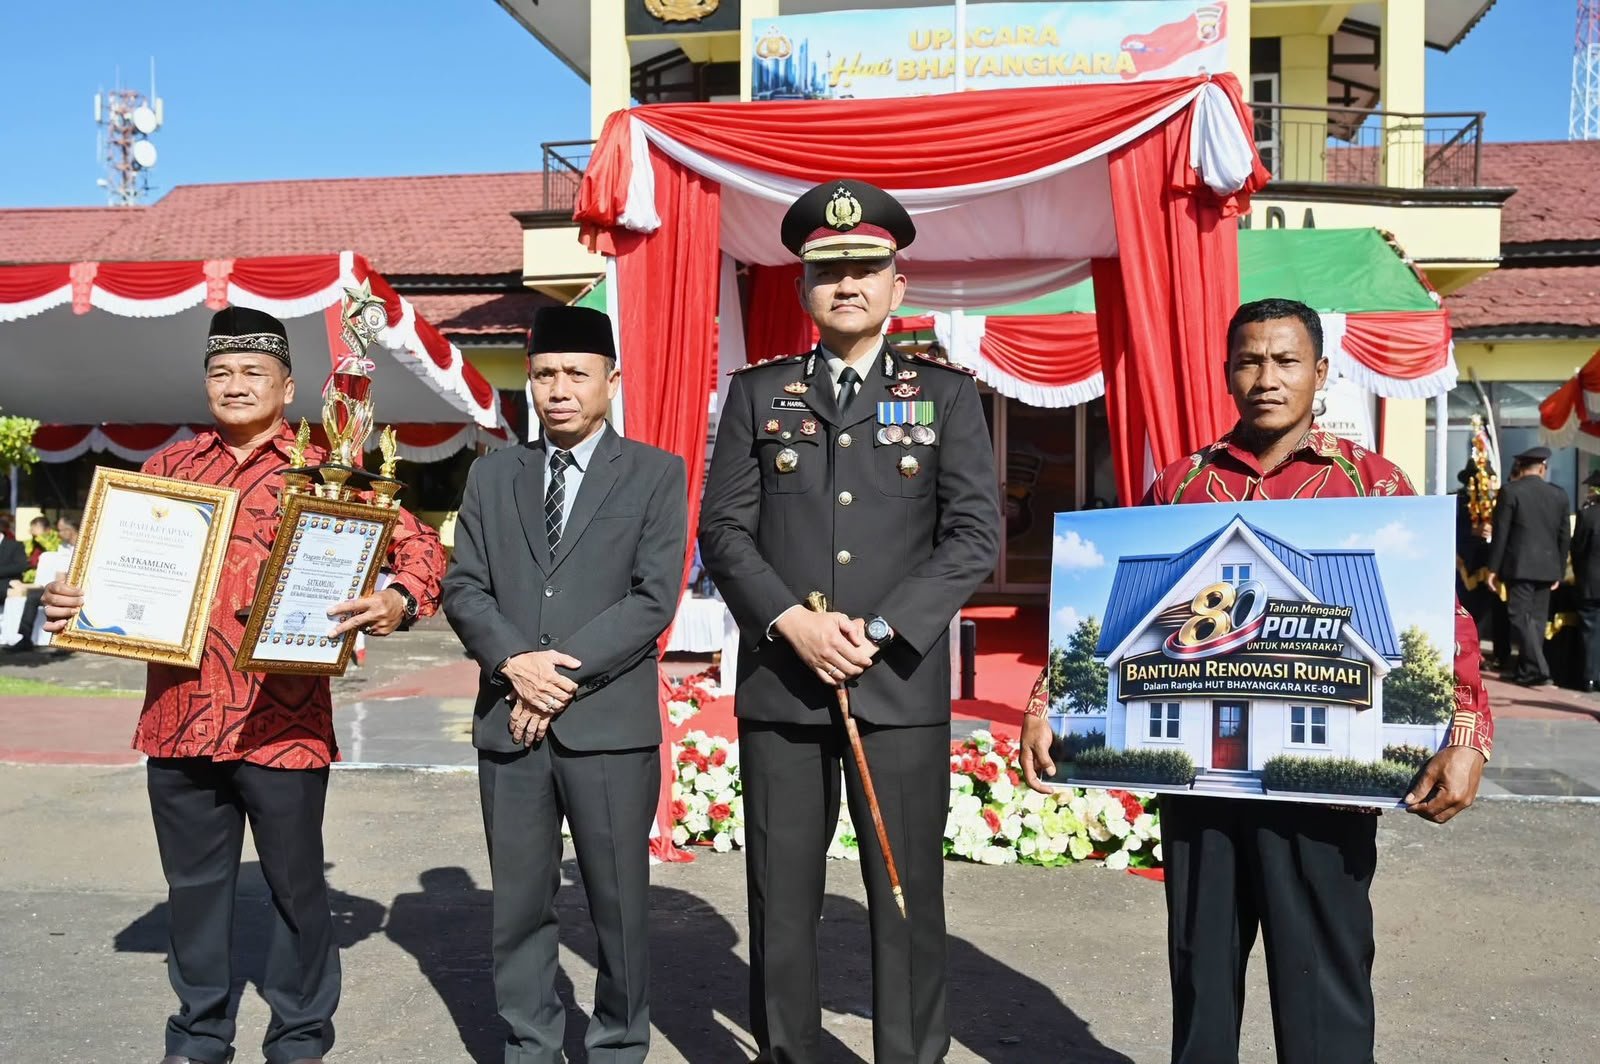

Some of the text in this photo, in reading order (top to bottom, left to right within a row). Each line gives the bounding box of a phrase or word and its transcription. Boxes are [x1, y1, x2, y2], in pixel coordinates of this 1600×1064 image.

[119, 555, 176, 570] SATKAMLING
[303, 553, 321, 562] Piagam
[322, 554, 352, 565] Penghargaan
[1177, 580, 1268, 646] 80
[1268, 602, 1352, 617] Tahun Mengabdi
[1261, 616, 1342, 640] POLRI
[1246, 642, 1344, 652] UNTUK MASYARAKAT
[1126, 661, 1361, 685] BANTUAN RENOVASI RUMAH
[1143, 680, 1336, 695] Dalam Rangka HUT BHAYANGKARA KE-80
